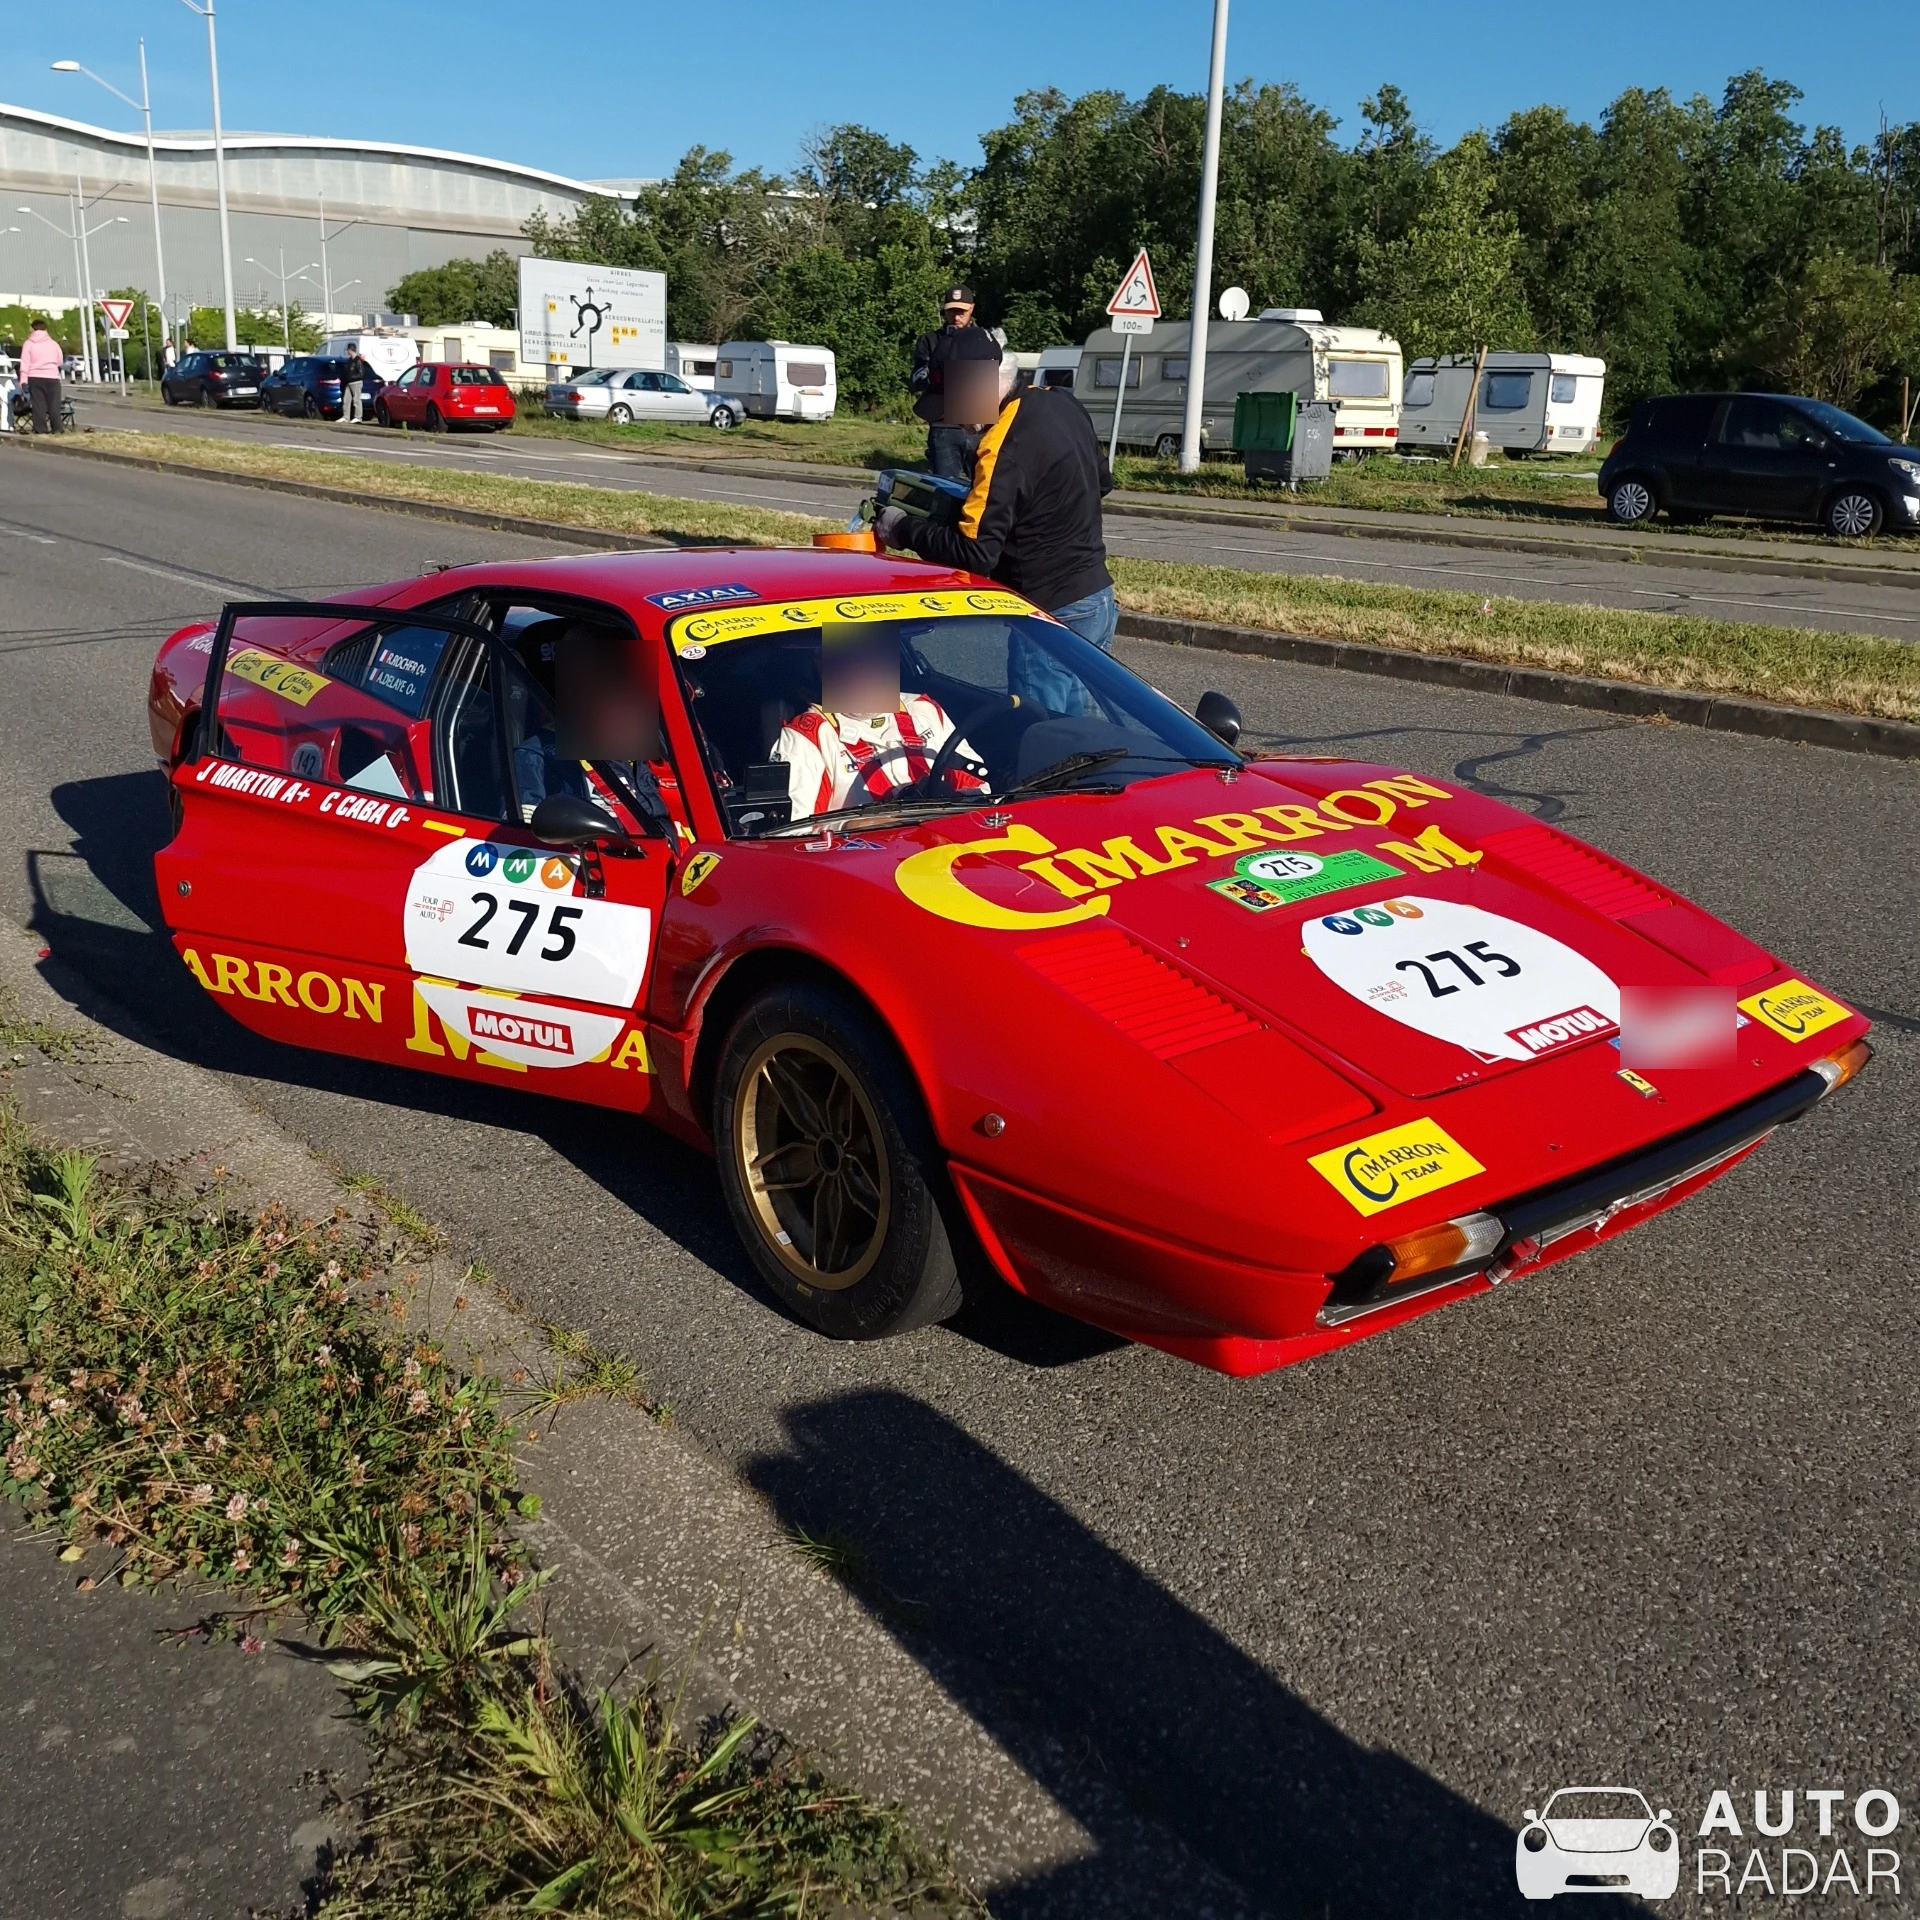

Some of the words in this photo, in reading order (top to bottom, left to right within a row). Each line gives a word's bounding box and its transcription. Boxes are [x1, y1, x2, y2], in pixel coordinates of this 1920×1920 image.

[661, 587, 754, 606] AXIAL
[870, 607, 899, 615] TEAM
[685, 616, 767, 642] CIMARRON
[724, 622, 757, 632] TEAM
[196, 761, 217, 781] J
[210, 763, 289, 800] MARTIN
[280, 782, 311, 803] A+
[319, 791, 341, 813] C
[335, 795, 391, 825] CABA
[895, 774, 1455, 932] CIMARRON
[1258, 856, 1314, 877] 275
[1270, 872, 1331, 892] EDMOND
[1287, 887, 1311, 900] DE
[1309, 870, 1390, 898] ROTHSCHILD
[422, 895, 439, 906] TOUR
[419, 910, 437, 920] AUTO
[457, 891, 584, 962] 275
[1395, 940, 1522, 998] 275
[1758, 992, 1824, 1035] CIMARRON
[1801, 1006, 1826, 1021] TEAM
[474, 1012, 569, 1050] MOTUL
[1517, 1009, 1611, 1051] MOTUL
[1343, 1141, 1451, 1203] CIMARRON
[1400, 1160, 1443, 1182] TEAM
